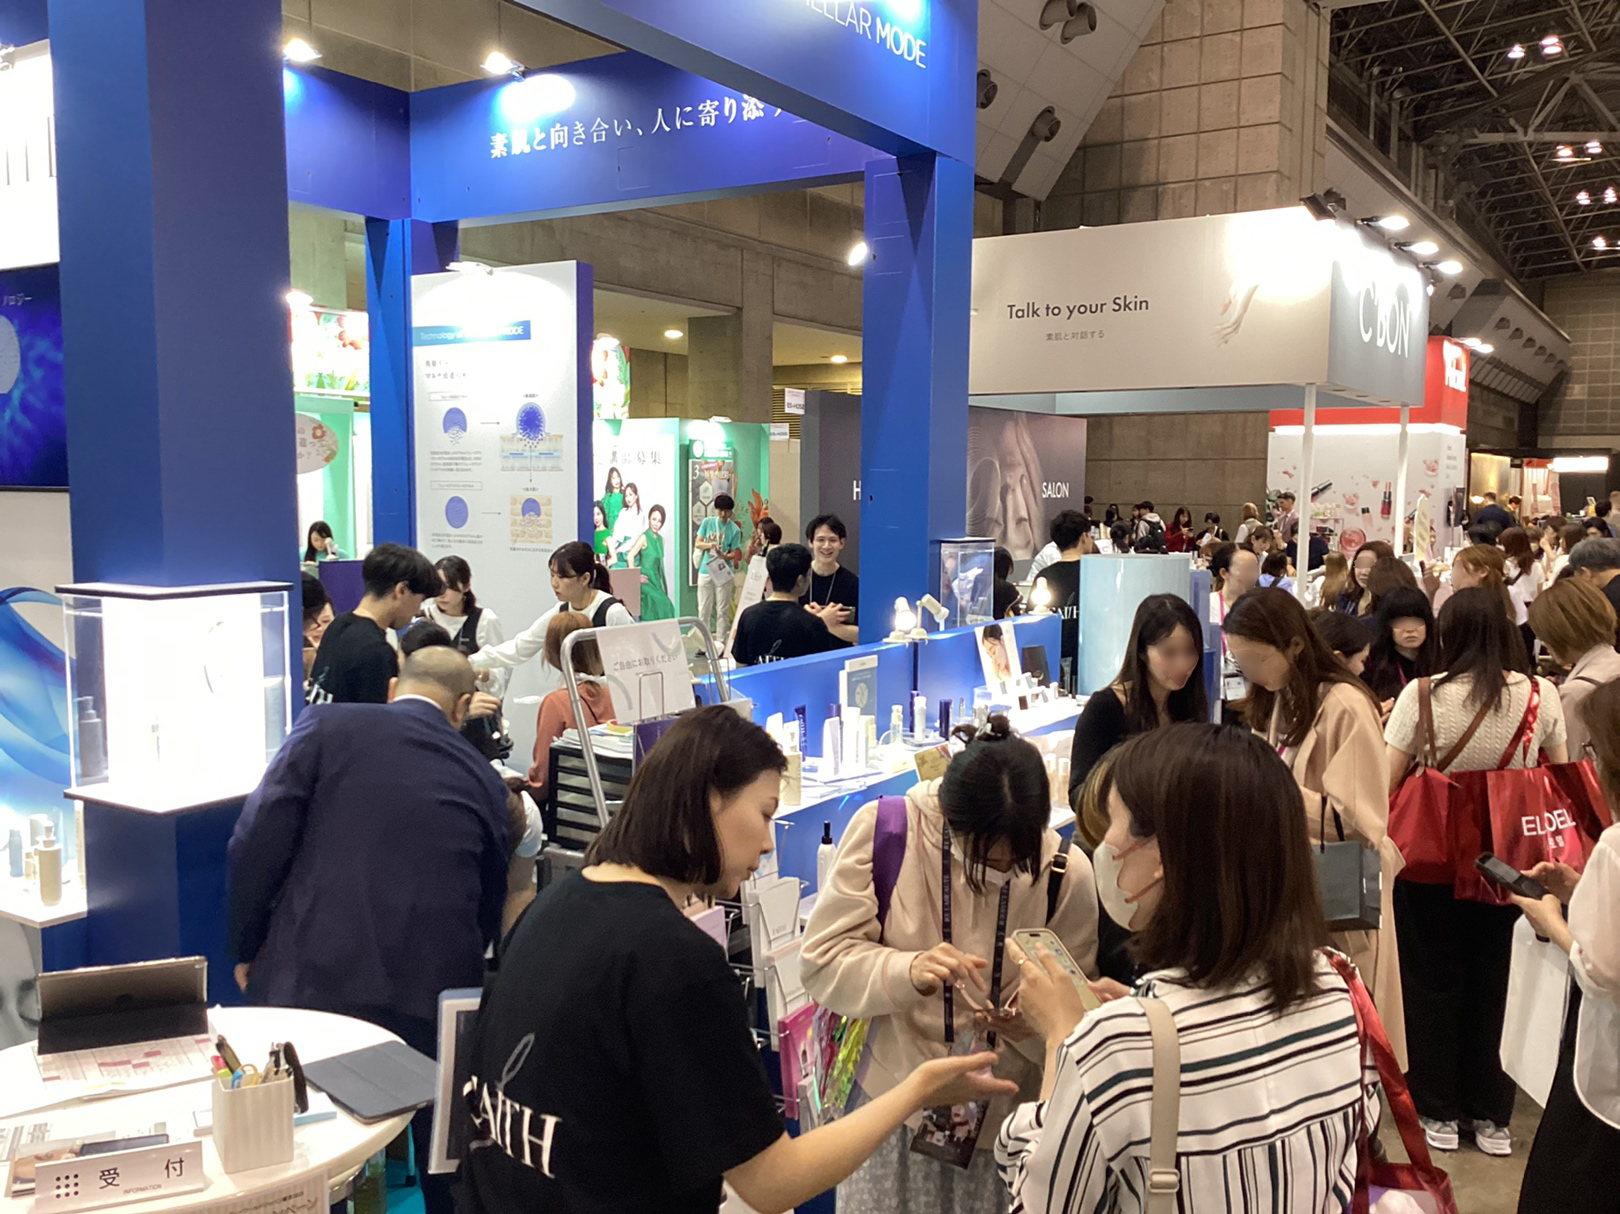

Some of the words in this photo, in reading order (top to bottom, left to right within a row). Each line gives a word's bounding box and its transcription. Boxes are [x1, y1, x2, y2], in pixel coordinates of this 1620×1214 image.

[876, 16, 927, 69] MODE
[489, 94, 782, 159] 素肌と向き合い、人に寄り添
[1007, 302, 1041, 319] Talk
[1045, 303, 1062, 317] to
[1066, 302, 1107, 320] your
[1112, 295, 1149, 312] Skin
[1045, 330, 1105, 341] 素肌と対話する
[1041, 482, 1070, 498] SALON
[613, 655, 679, 671] ご自由にお取りください
[1521, 808, 1577, 836] ELOEL
[122, 1183, 163, 1196] INFORMATION
